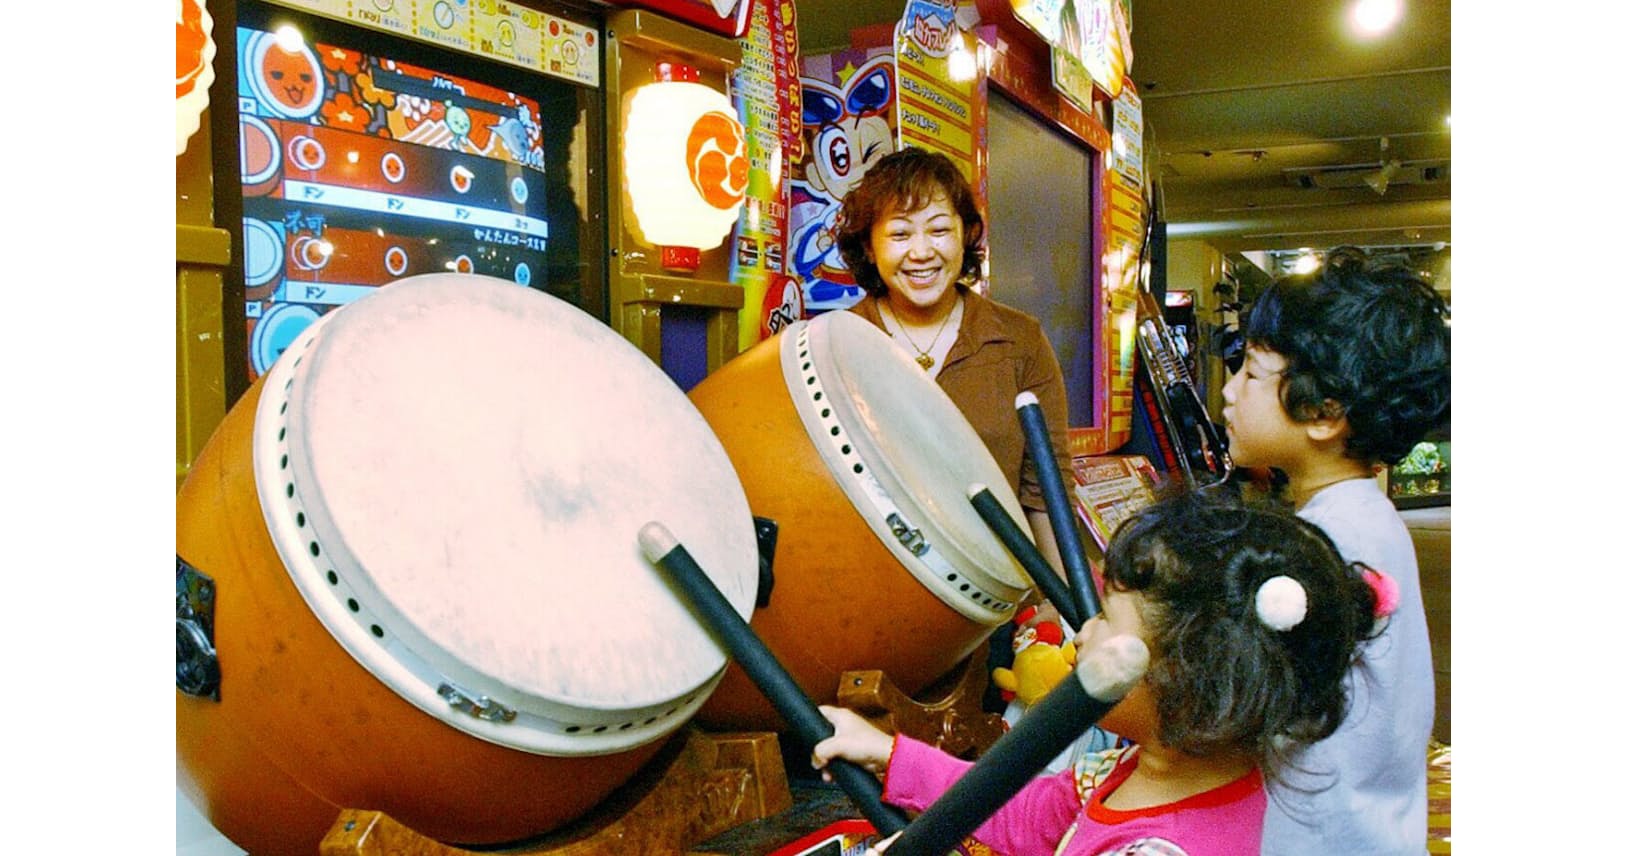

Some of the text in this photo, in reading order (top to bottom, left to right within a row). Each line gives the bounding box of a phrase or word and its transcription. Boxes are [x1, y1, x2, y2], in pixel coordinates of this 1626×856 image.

[304, 185, 325, 199] ドン
[387, 198, 404, 210] ドン
[285, 210, 325, 236] 不可
[305, 286, 327, 299] ドン
